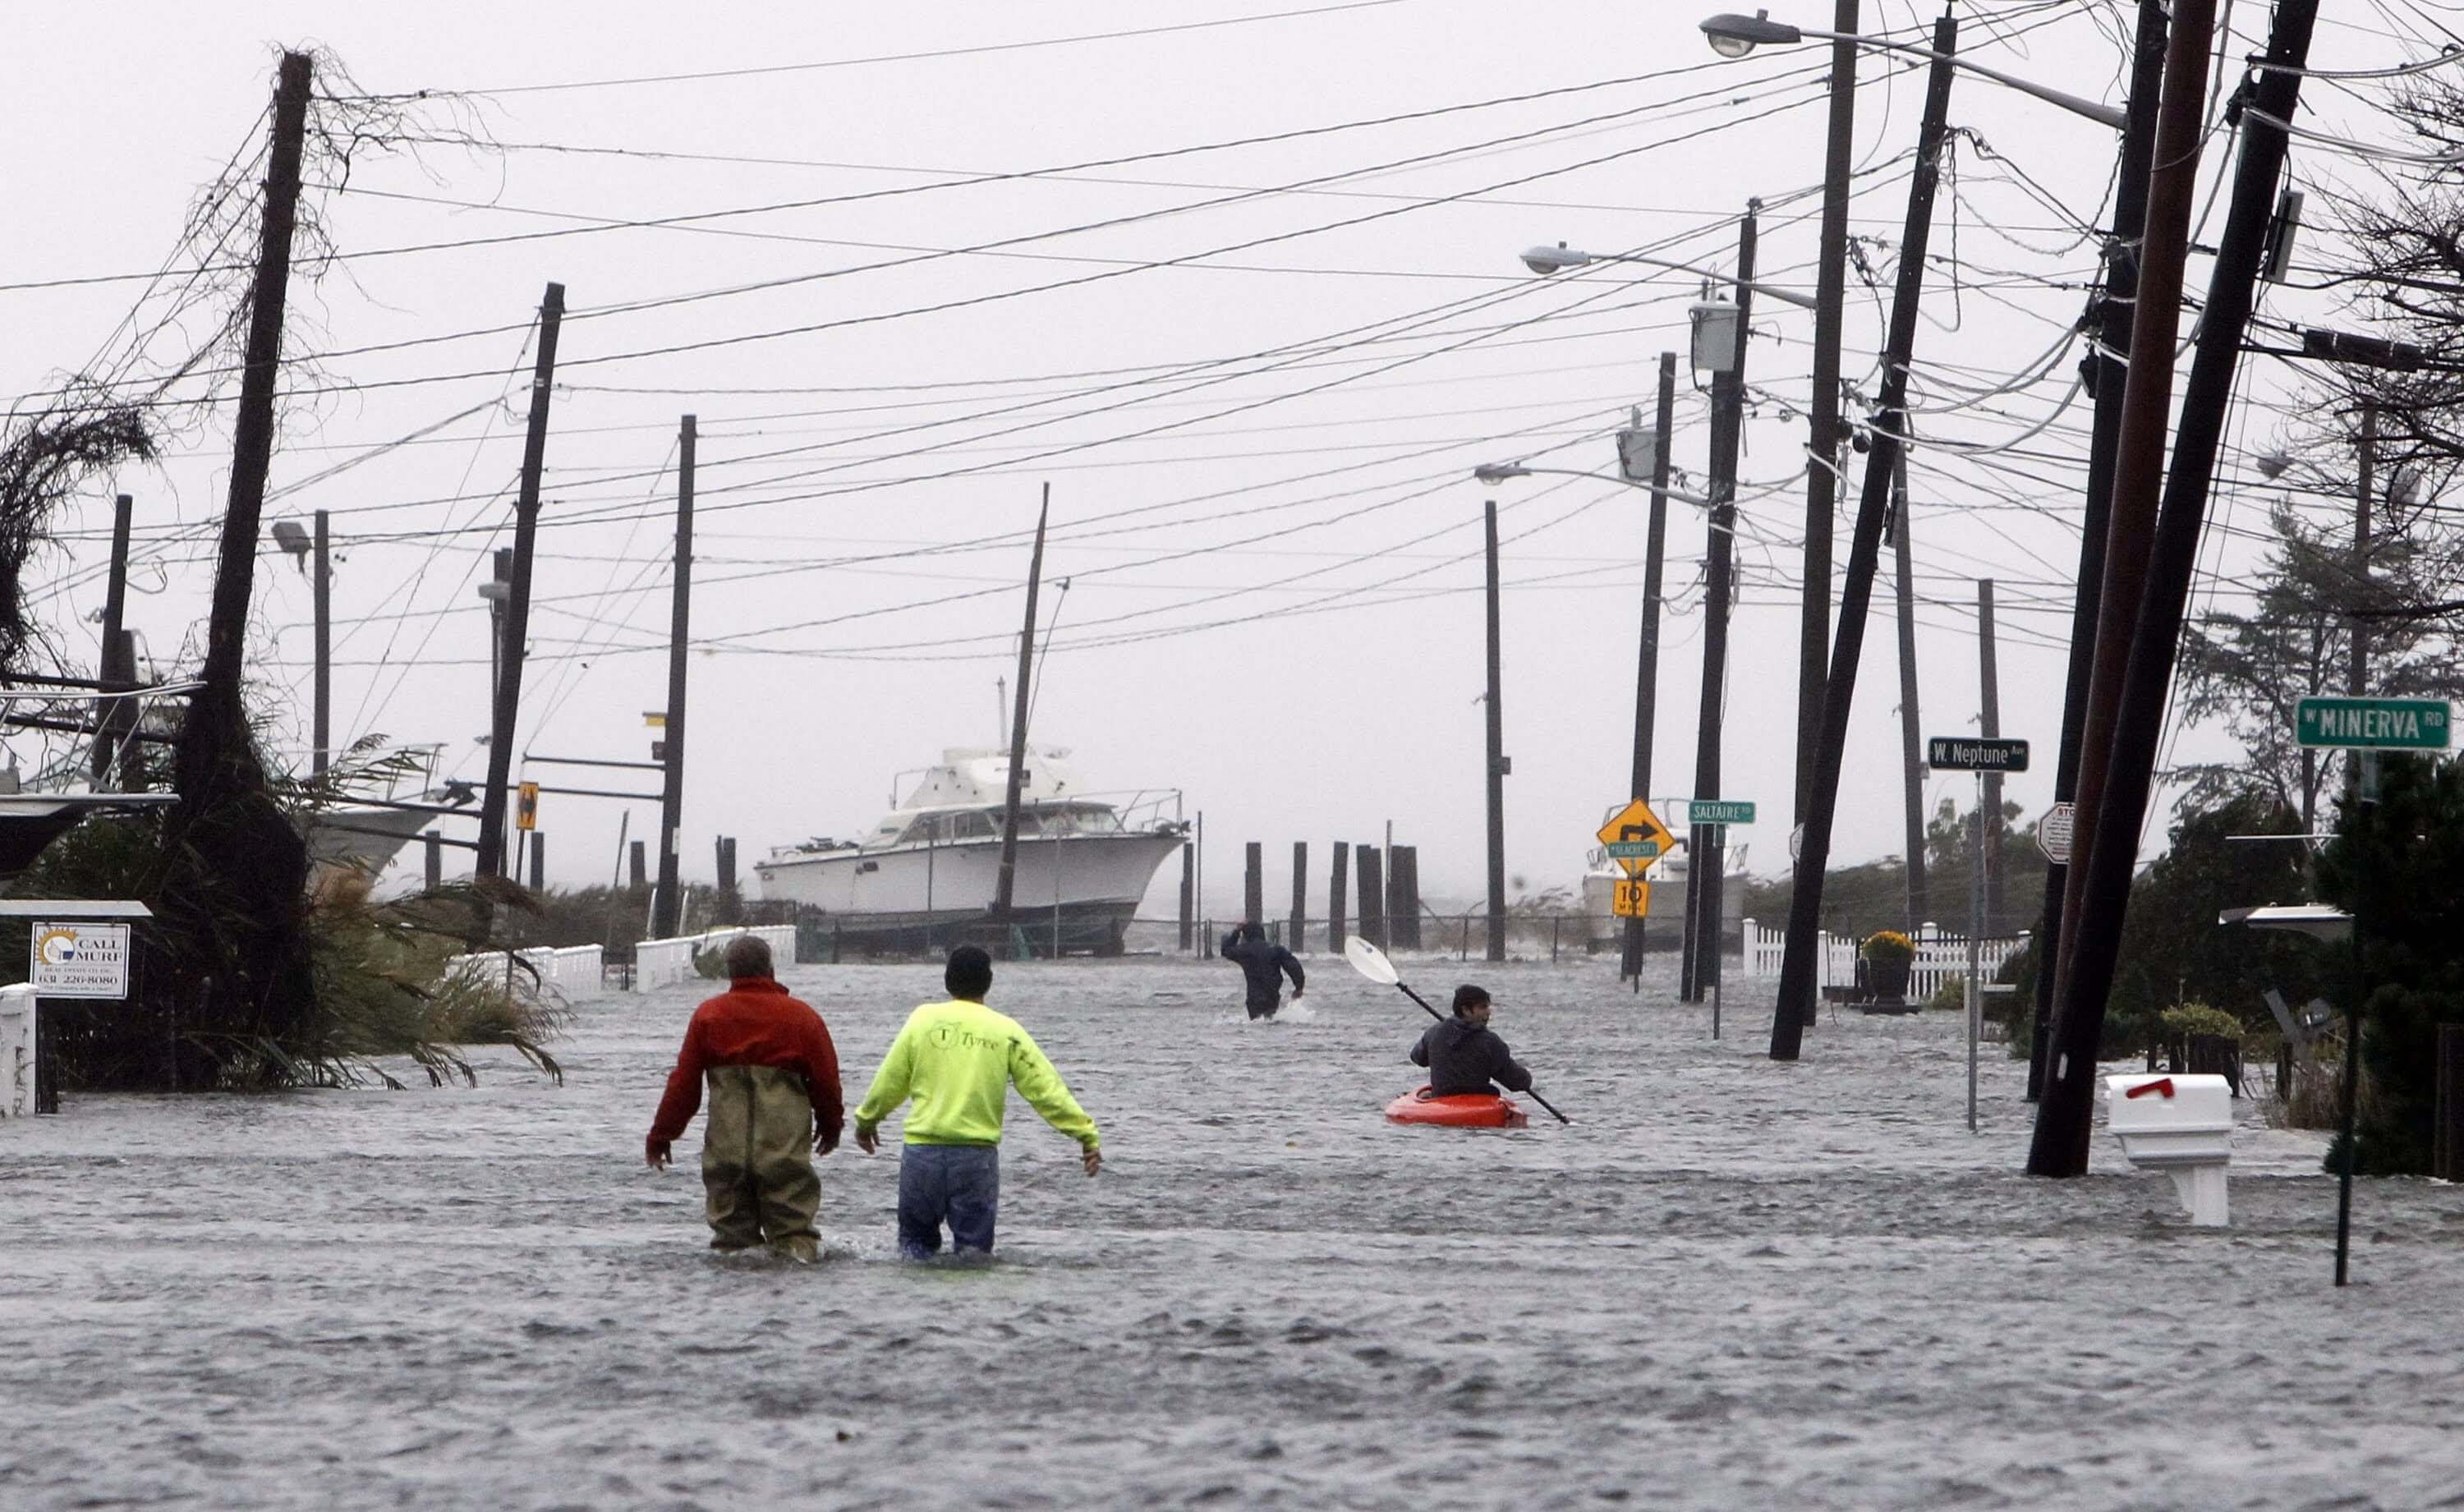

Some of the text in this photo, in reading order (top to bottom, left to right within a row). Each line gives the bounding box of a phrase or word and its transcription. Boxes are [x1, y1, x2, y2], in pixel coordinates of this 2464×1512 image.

[2304, 708, 2444, 738] W MINERVA RD
[1933, 742, 1947, 762] W.
[1953, 743, 2008, 766] Neptune
[1694, 806, 1740, 820] SALTAIRE
[1622, 886, 1642, 903] 10
[79, 940, 121, 949] CALL
[39, 974, 117, 985] 631 226-8080
[962, 1032, 1000, 1050] Tyree
